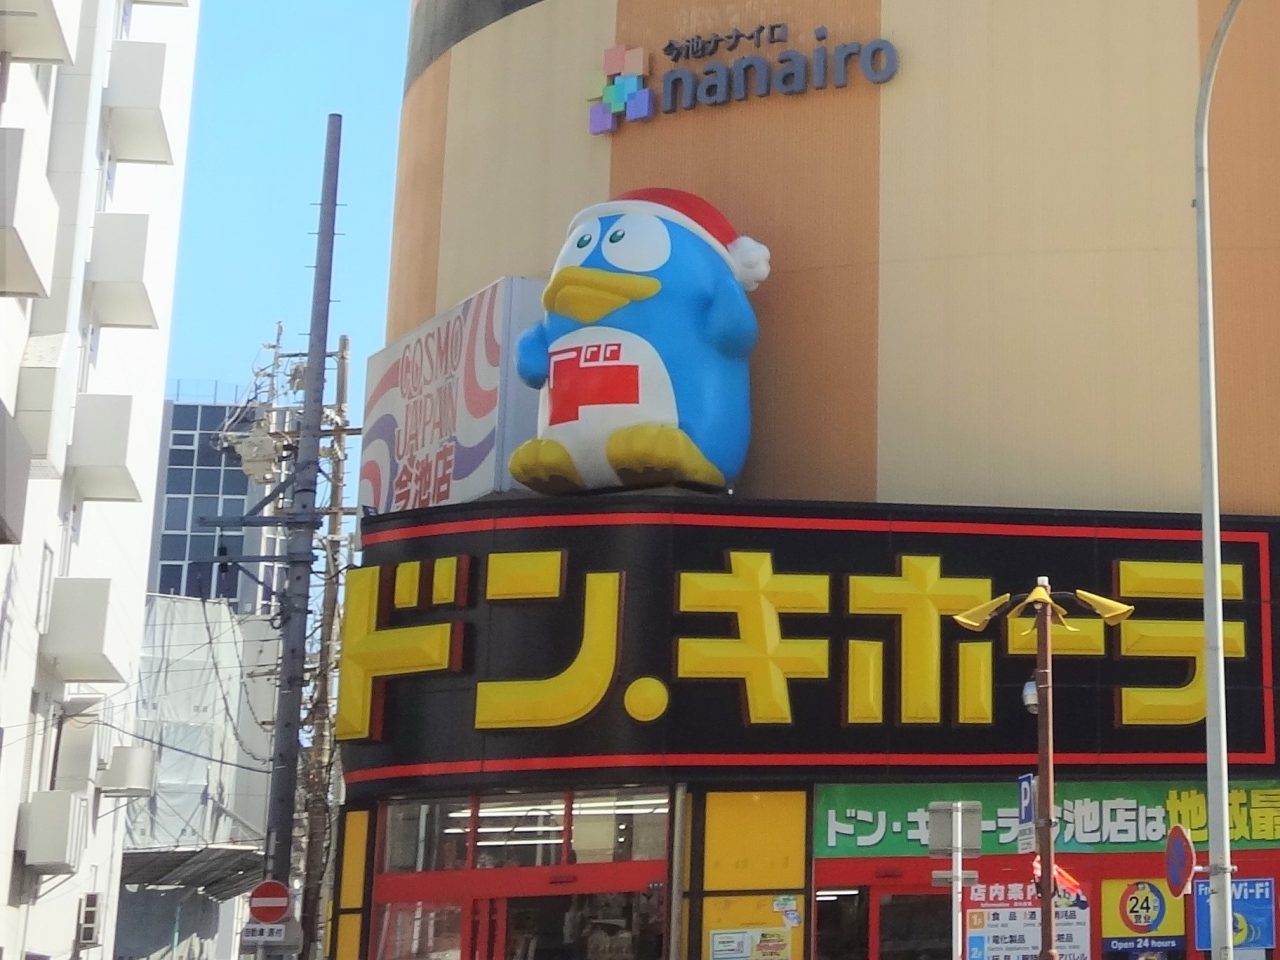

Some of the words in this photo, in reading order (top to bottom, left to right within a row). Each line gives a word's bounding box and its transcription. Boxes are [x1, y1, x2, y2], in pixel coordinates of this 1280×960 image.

[662, 26, 899, 114] nanairo
[400, 315, 464, 397] COSMO
[395, 377, 460, 462] JAPAN
[394, 444, 454, 511] 今池店
[1021, 781, 1031, 820] P
[1129, 896, 1151, 914] 24
[1055, 934, 1074, 943] 粧品
[1111, 940, 1134, 950] Open
[1136, 939, 1150, 948] 24
[1151, 939, 1176, 948] hours
